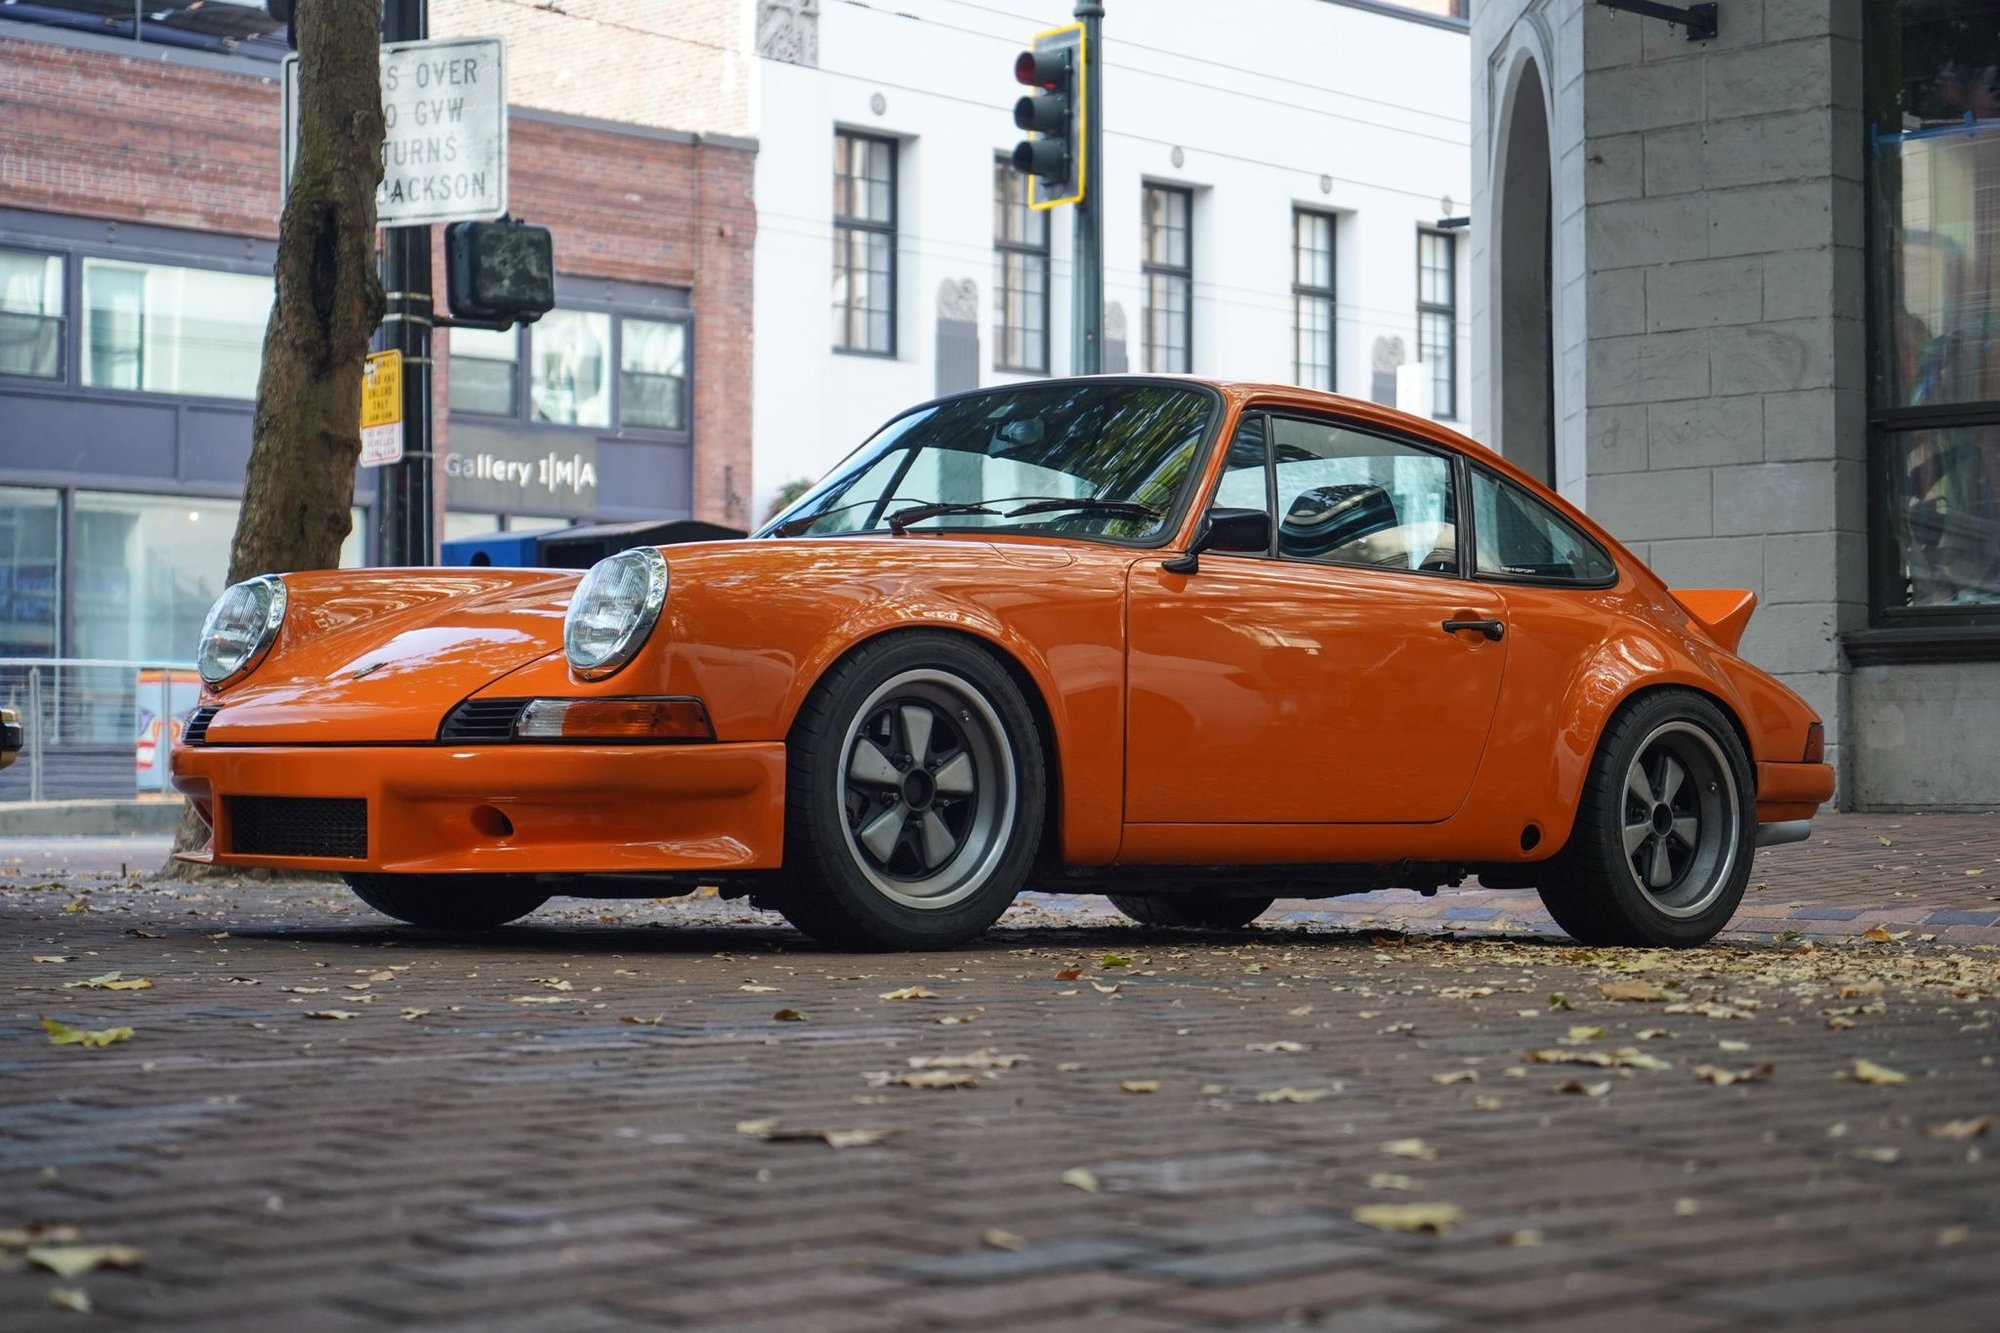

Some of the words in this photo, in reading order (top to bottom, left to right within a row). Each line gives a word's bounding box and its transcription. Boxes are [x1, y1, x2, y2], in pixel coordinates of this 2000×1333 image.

[416, 58, 478, 89] OVER
[414, 97, 464, 126] GVW
[444, 452, 534, 488] Gallery
